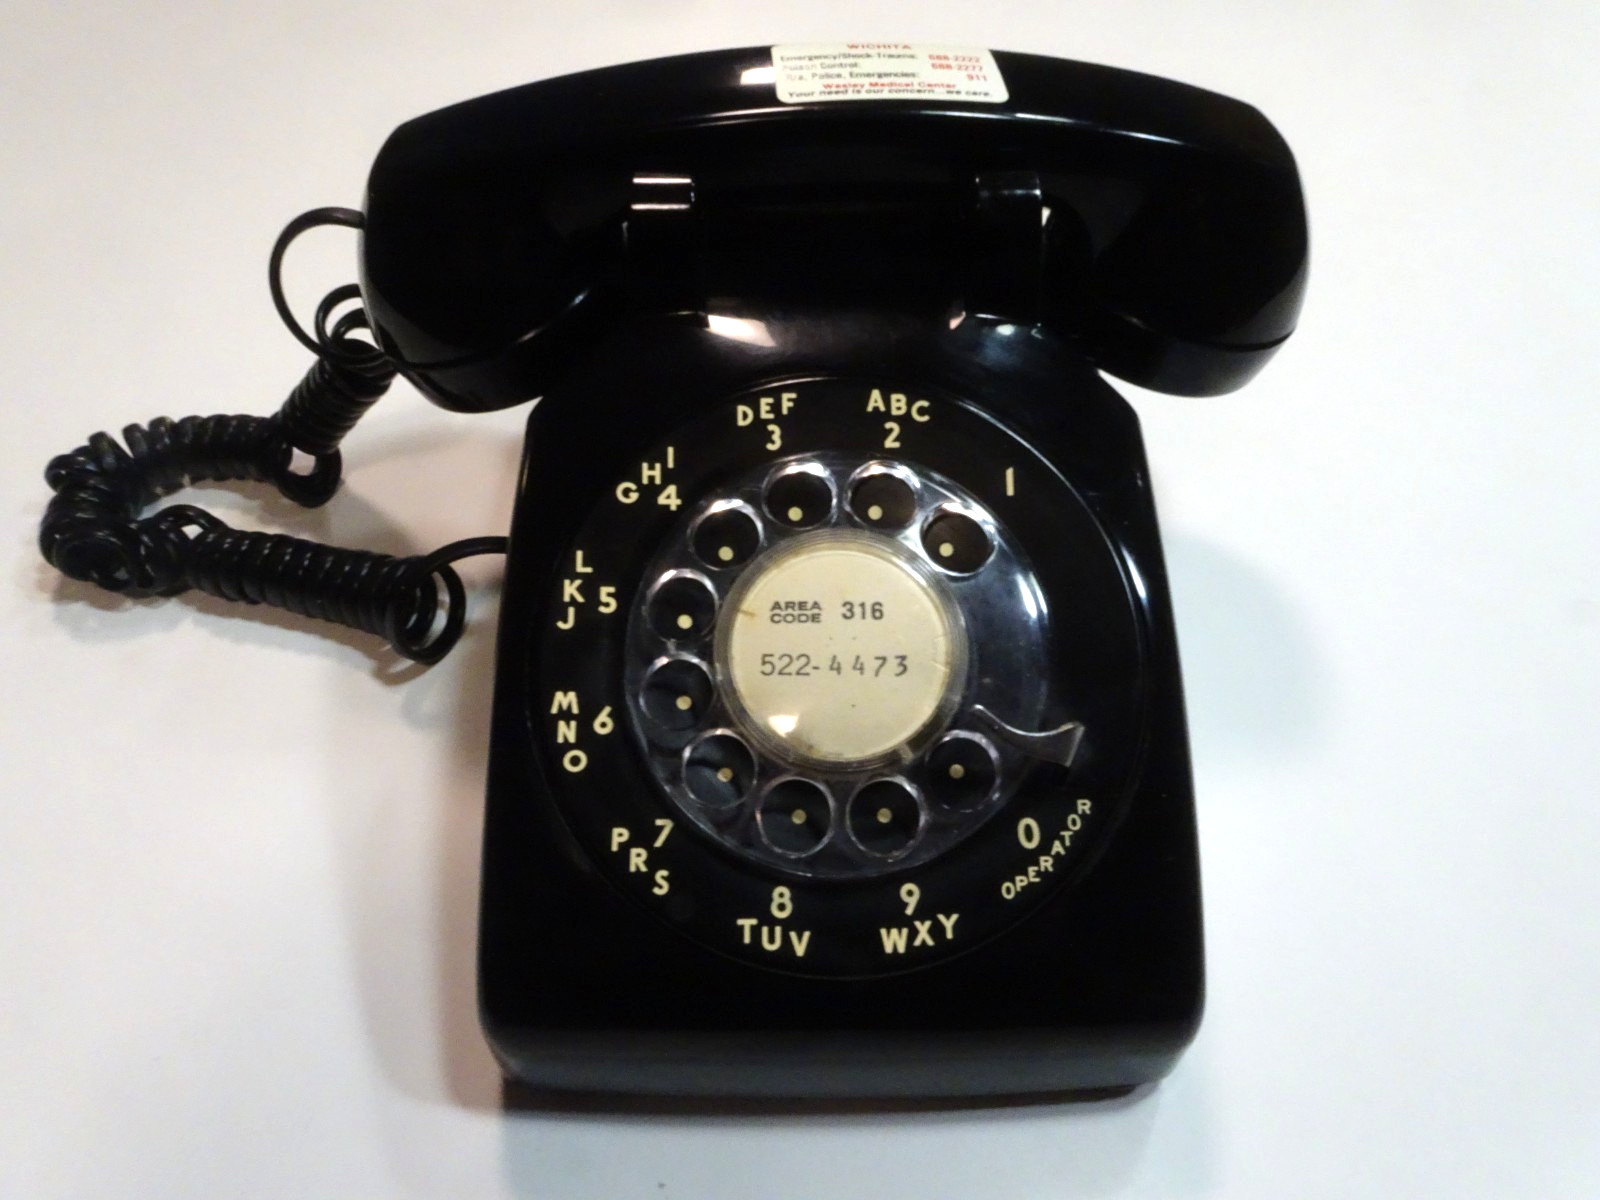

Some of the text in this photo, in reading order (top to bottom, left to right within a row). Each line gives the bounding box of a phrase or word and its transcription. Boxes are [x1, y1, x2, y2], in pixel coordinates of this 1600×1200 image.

[846, 42, 912, 50] WICHITA
[818, 62, 861, 70] Control:
[849, 70, 920, 80] Emergencies:
[967, 74, 989, 82] 911
[822, 82, 865, 90] Wesley
[765, 424, 782, 451] 3
[884, 422, 903, 449] 2
[657, 484, 682, 511] 4
[598, 586, 618, 614] 5
[770, 601, 822, 611] AREA
[841, 602, 884, 620] 316
[770, 613, 822, 623] CODE
[593, 706, 613, 735] 6
[653, 819, 673, 848] 7
[1002, 800, 1091, 900] OPERATOR
[770, 886, 793, 919] 8
[900, 883, 920, 916] 9
